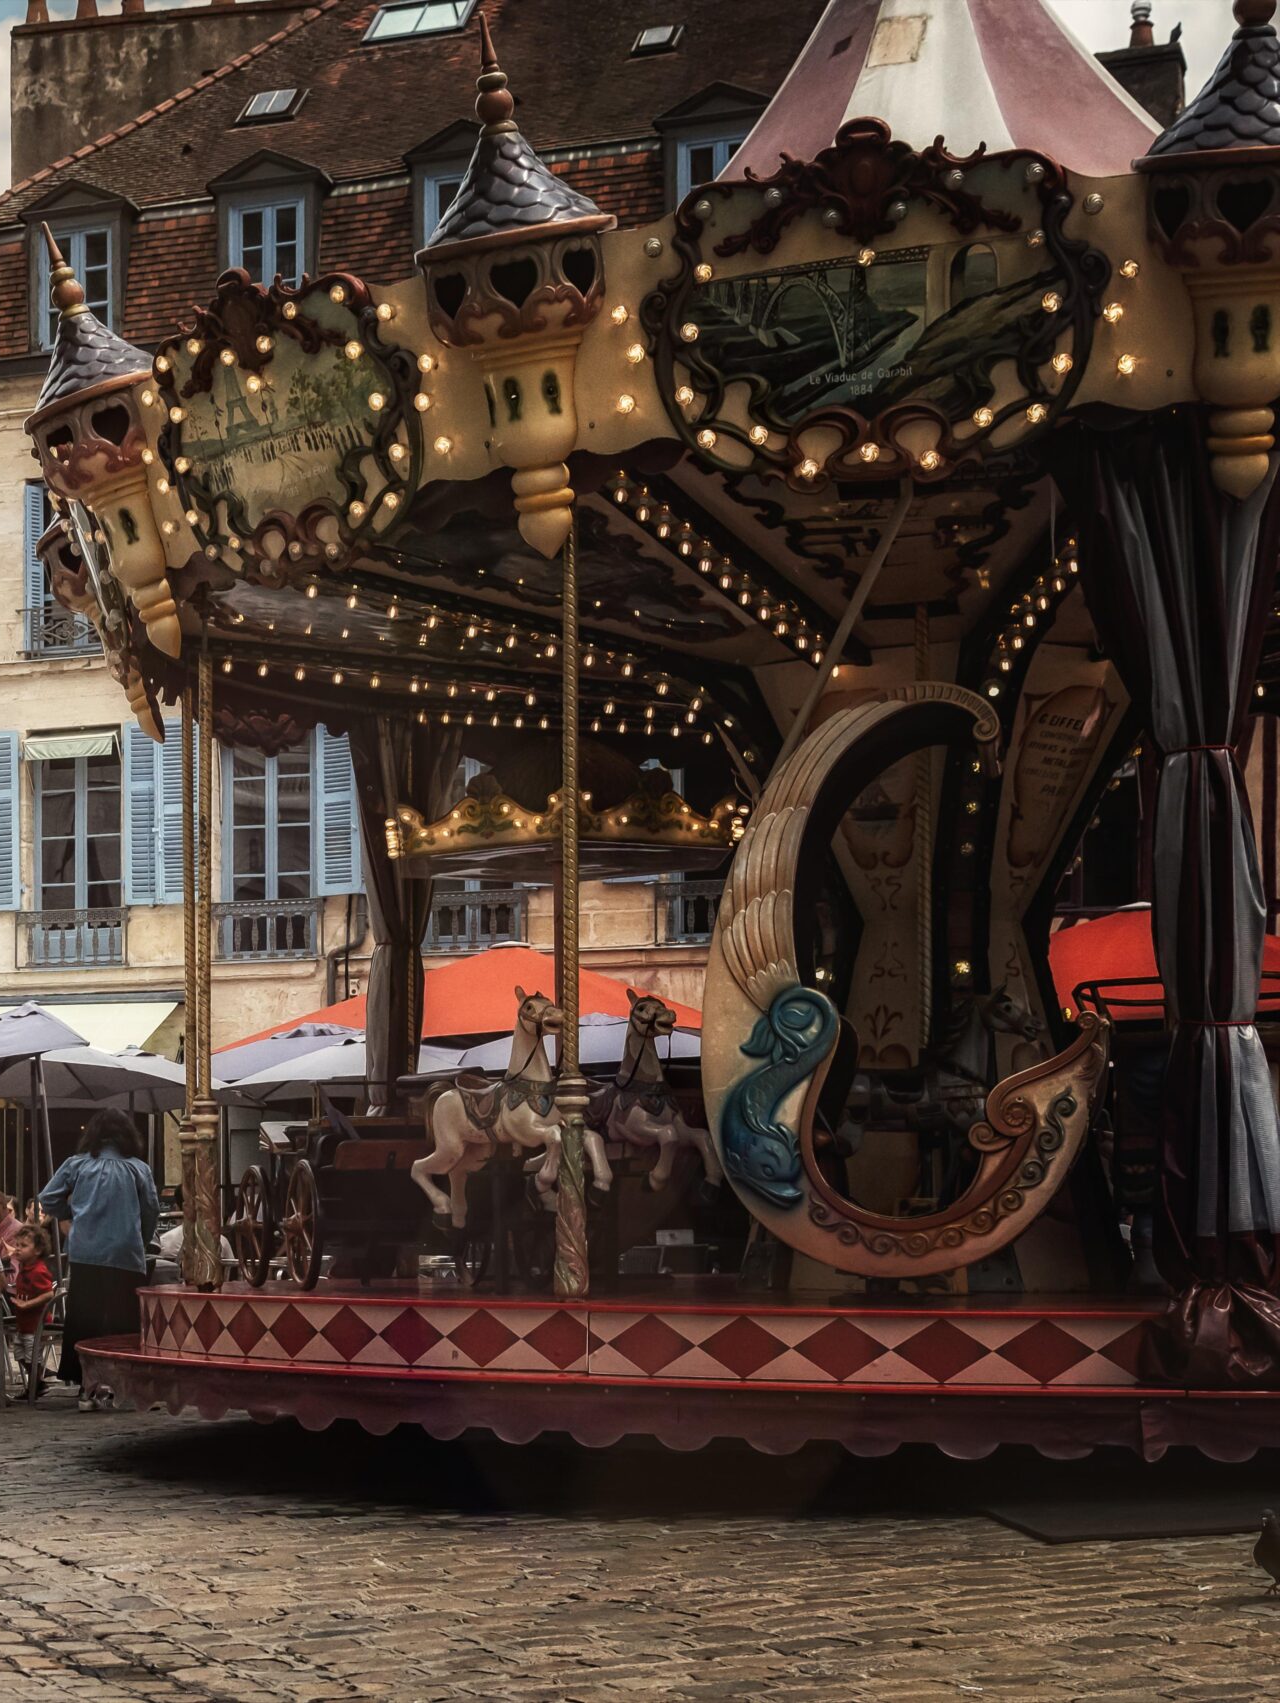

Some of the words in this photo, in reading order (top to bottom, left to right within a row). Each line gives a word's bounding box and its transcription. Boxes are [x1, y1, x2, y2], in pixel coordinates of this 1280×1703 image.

[809, 375, 821, 385] Le
[825, 371, 857, 384] Viaduc
[861, 370, 873, 381] de
[849, 384, 873, 395] 1884
